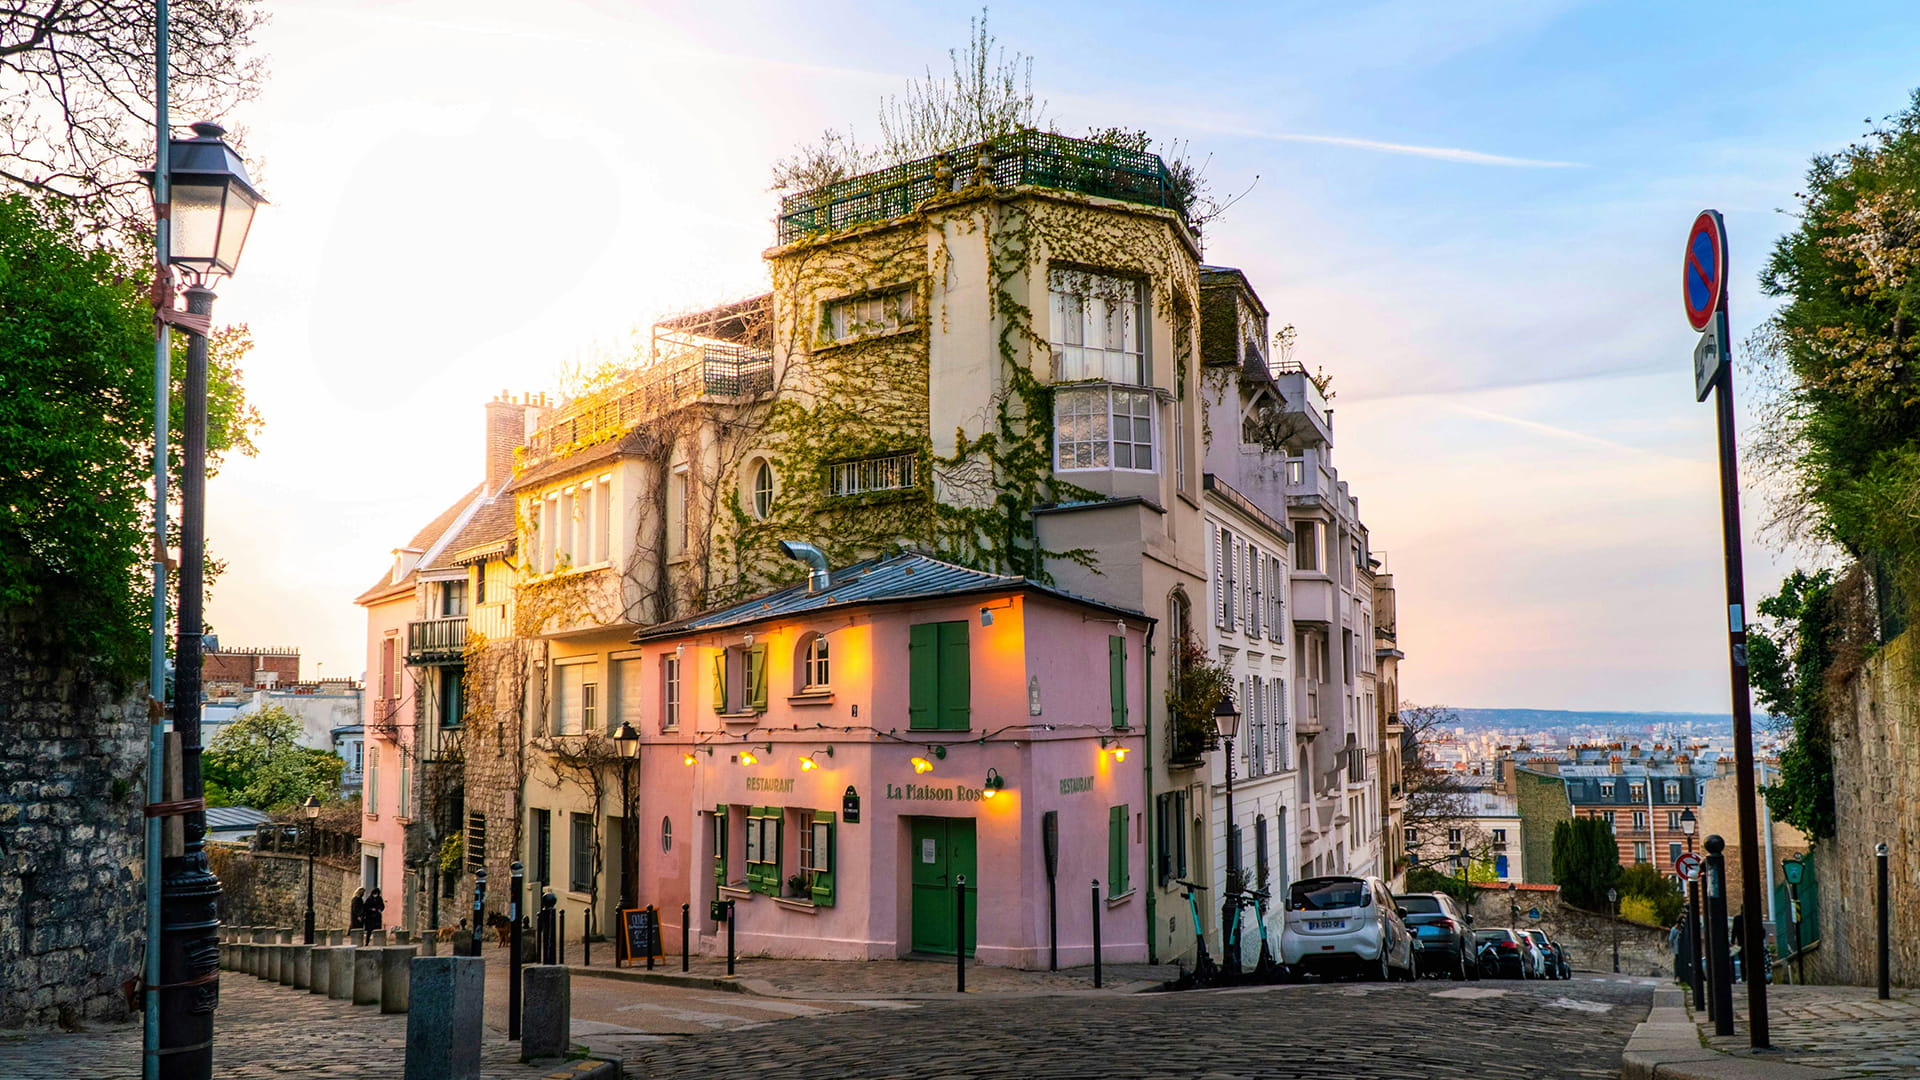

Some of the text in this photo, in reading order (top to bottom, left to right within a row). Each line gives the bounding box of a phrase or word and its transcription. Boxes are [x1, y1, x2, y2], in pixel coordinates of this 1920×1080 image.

[746, 777, 795, 793] RESTAURANT
[886, 783, 902, 800] La
[905, 784, 953, 801] Maison
[1059, 775, 1095, 795] RESTAURANT
